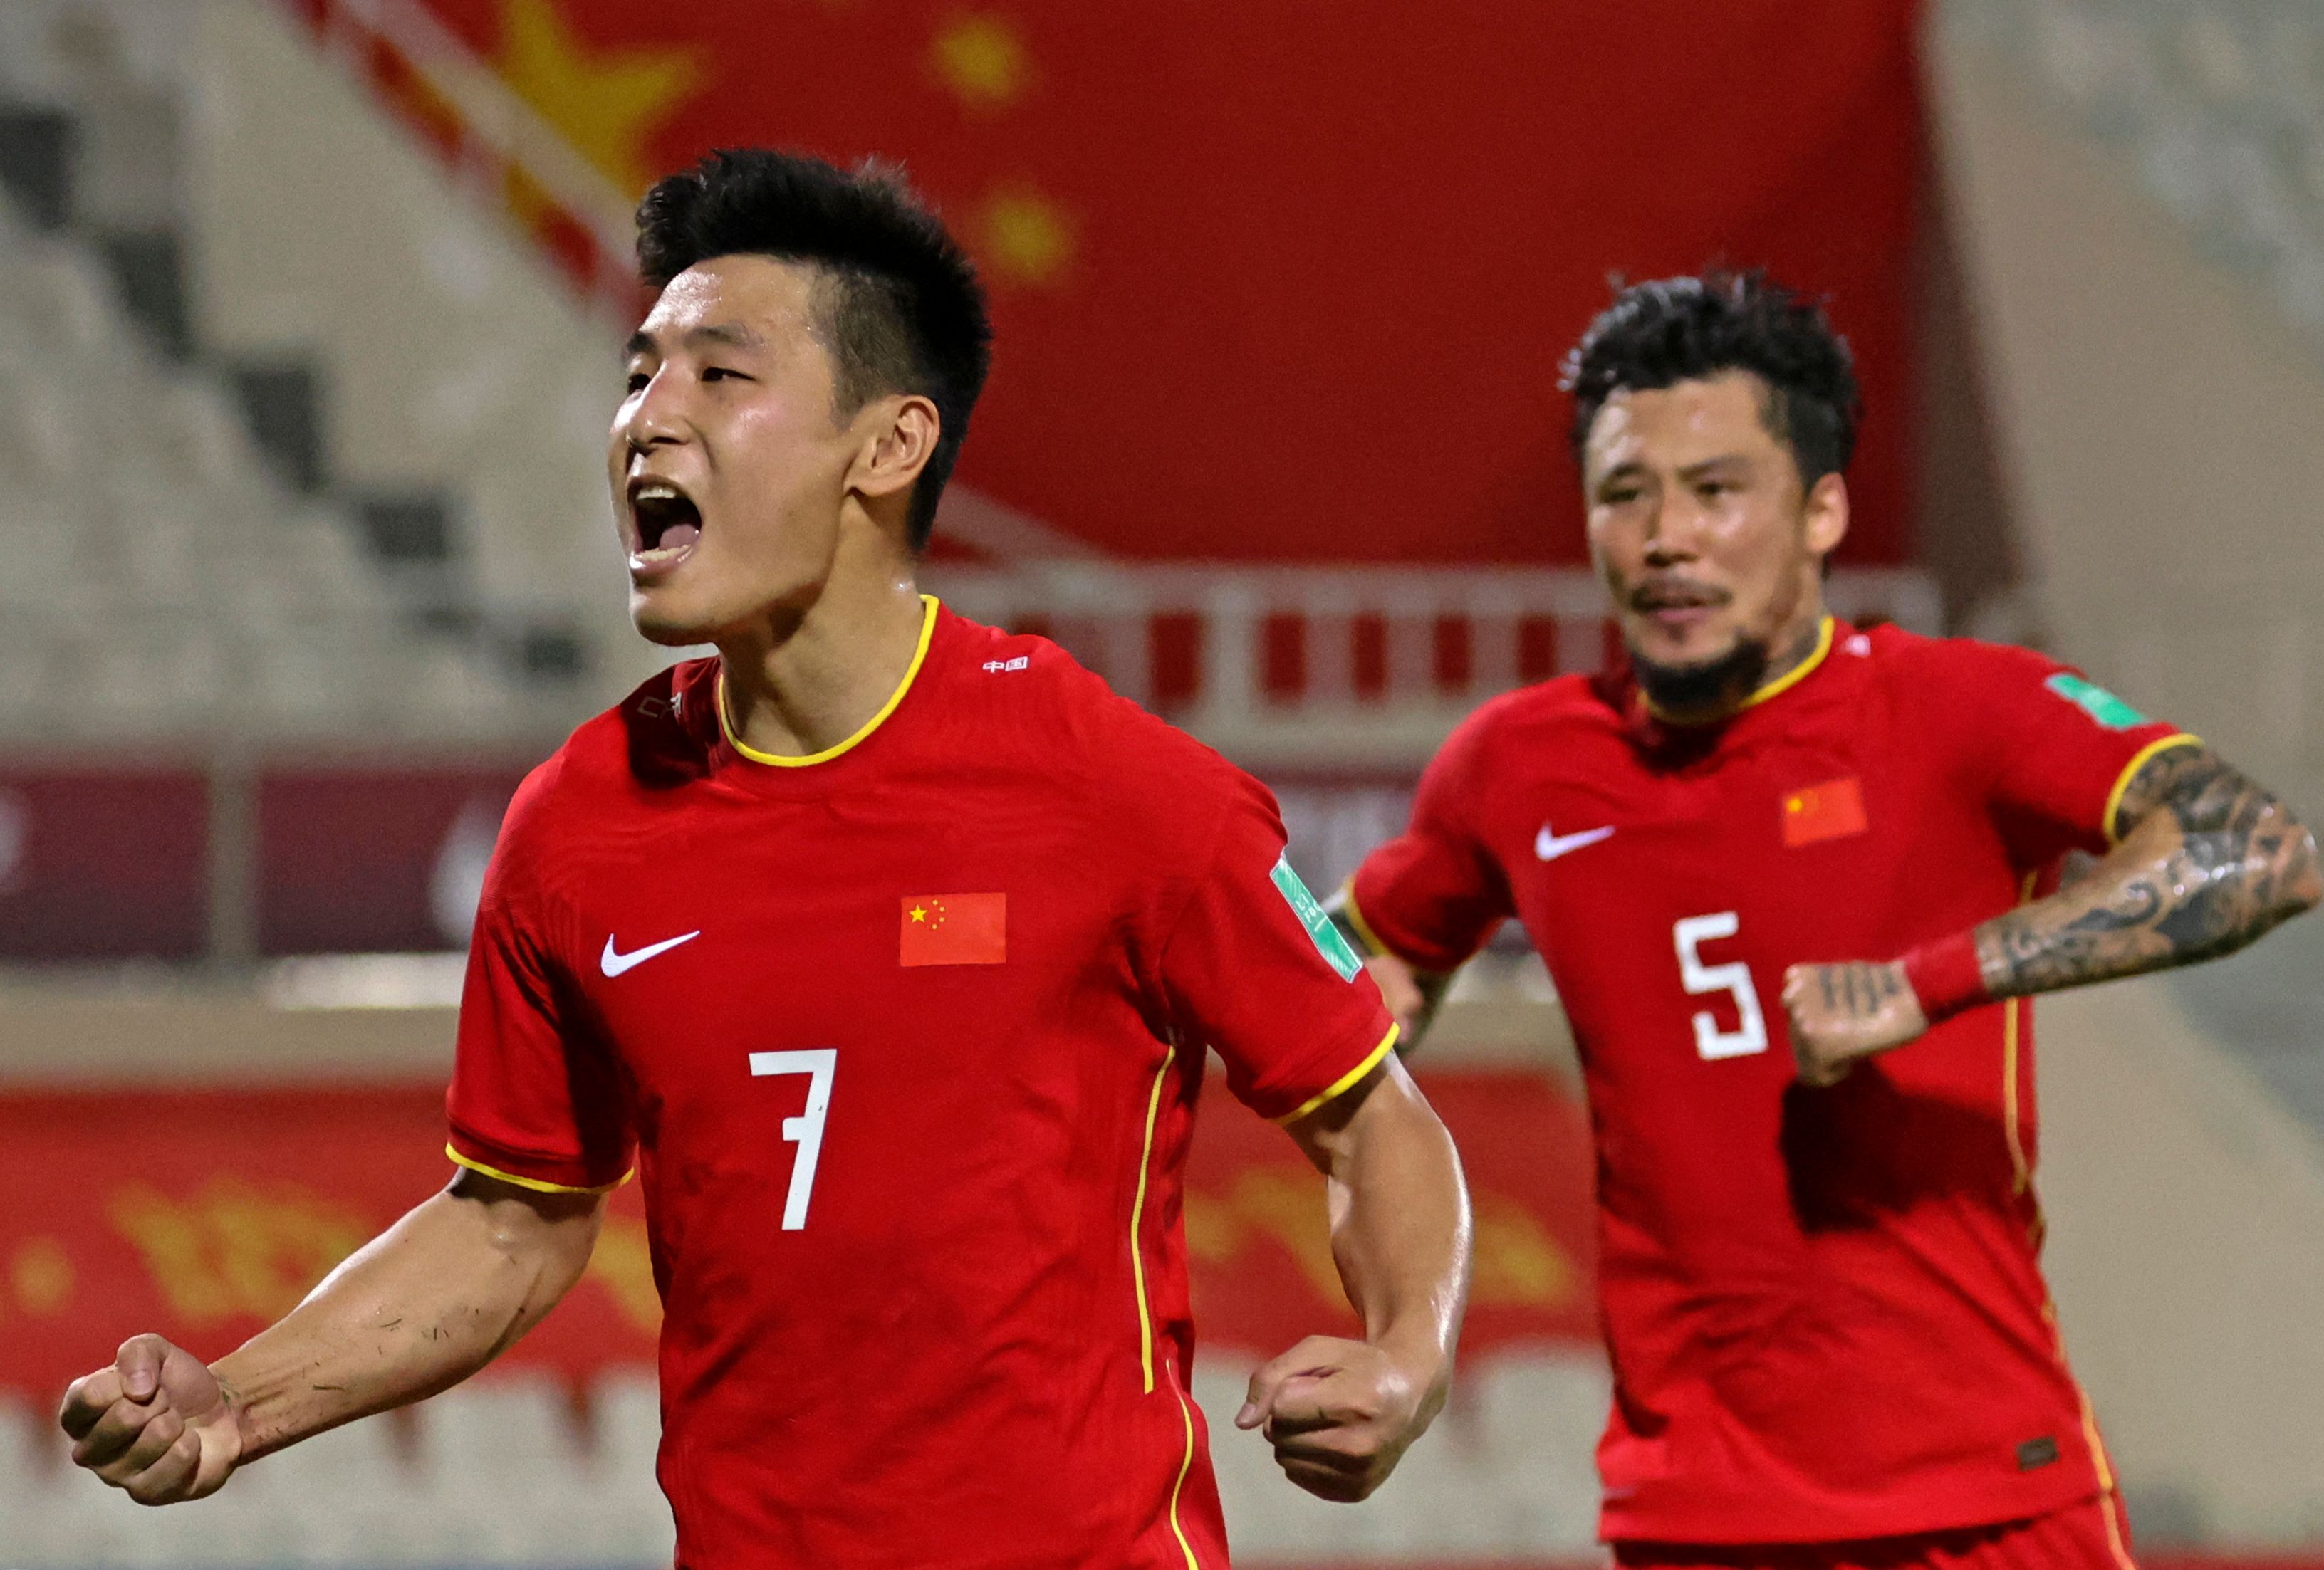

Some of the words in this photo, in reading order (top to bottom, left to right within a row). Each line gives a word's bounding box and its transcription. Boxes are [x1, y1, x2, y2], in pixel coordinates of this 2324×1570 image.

[982, 656, 1028, 673] 中国
[1674, 912, 1768, 1059] 5
[749, 1048, 837, 1230] 7
